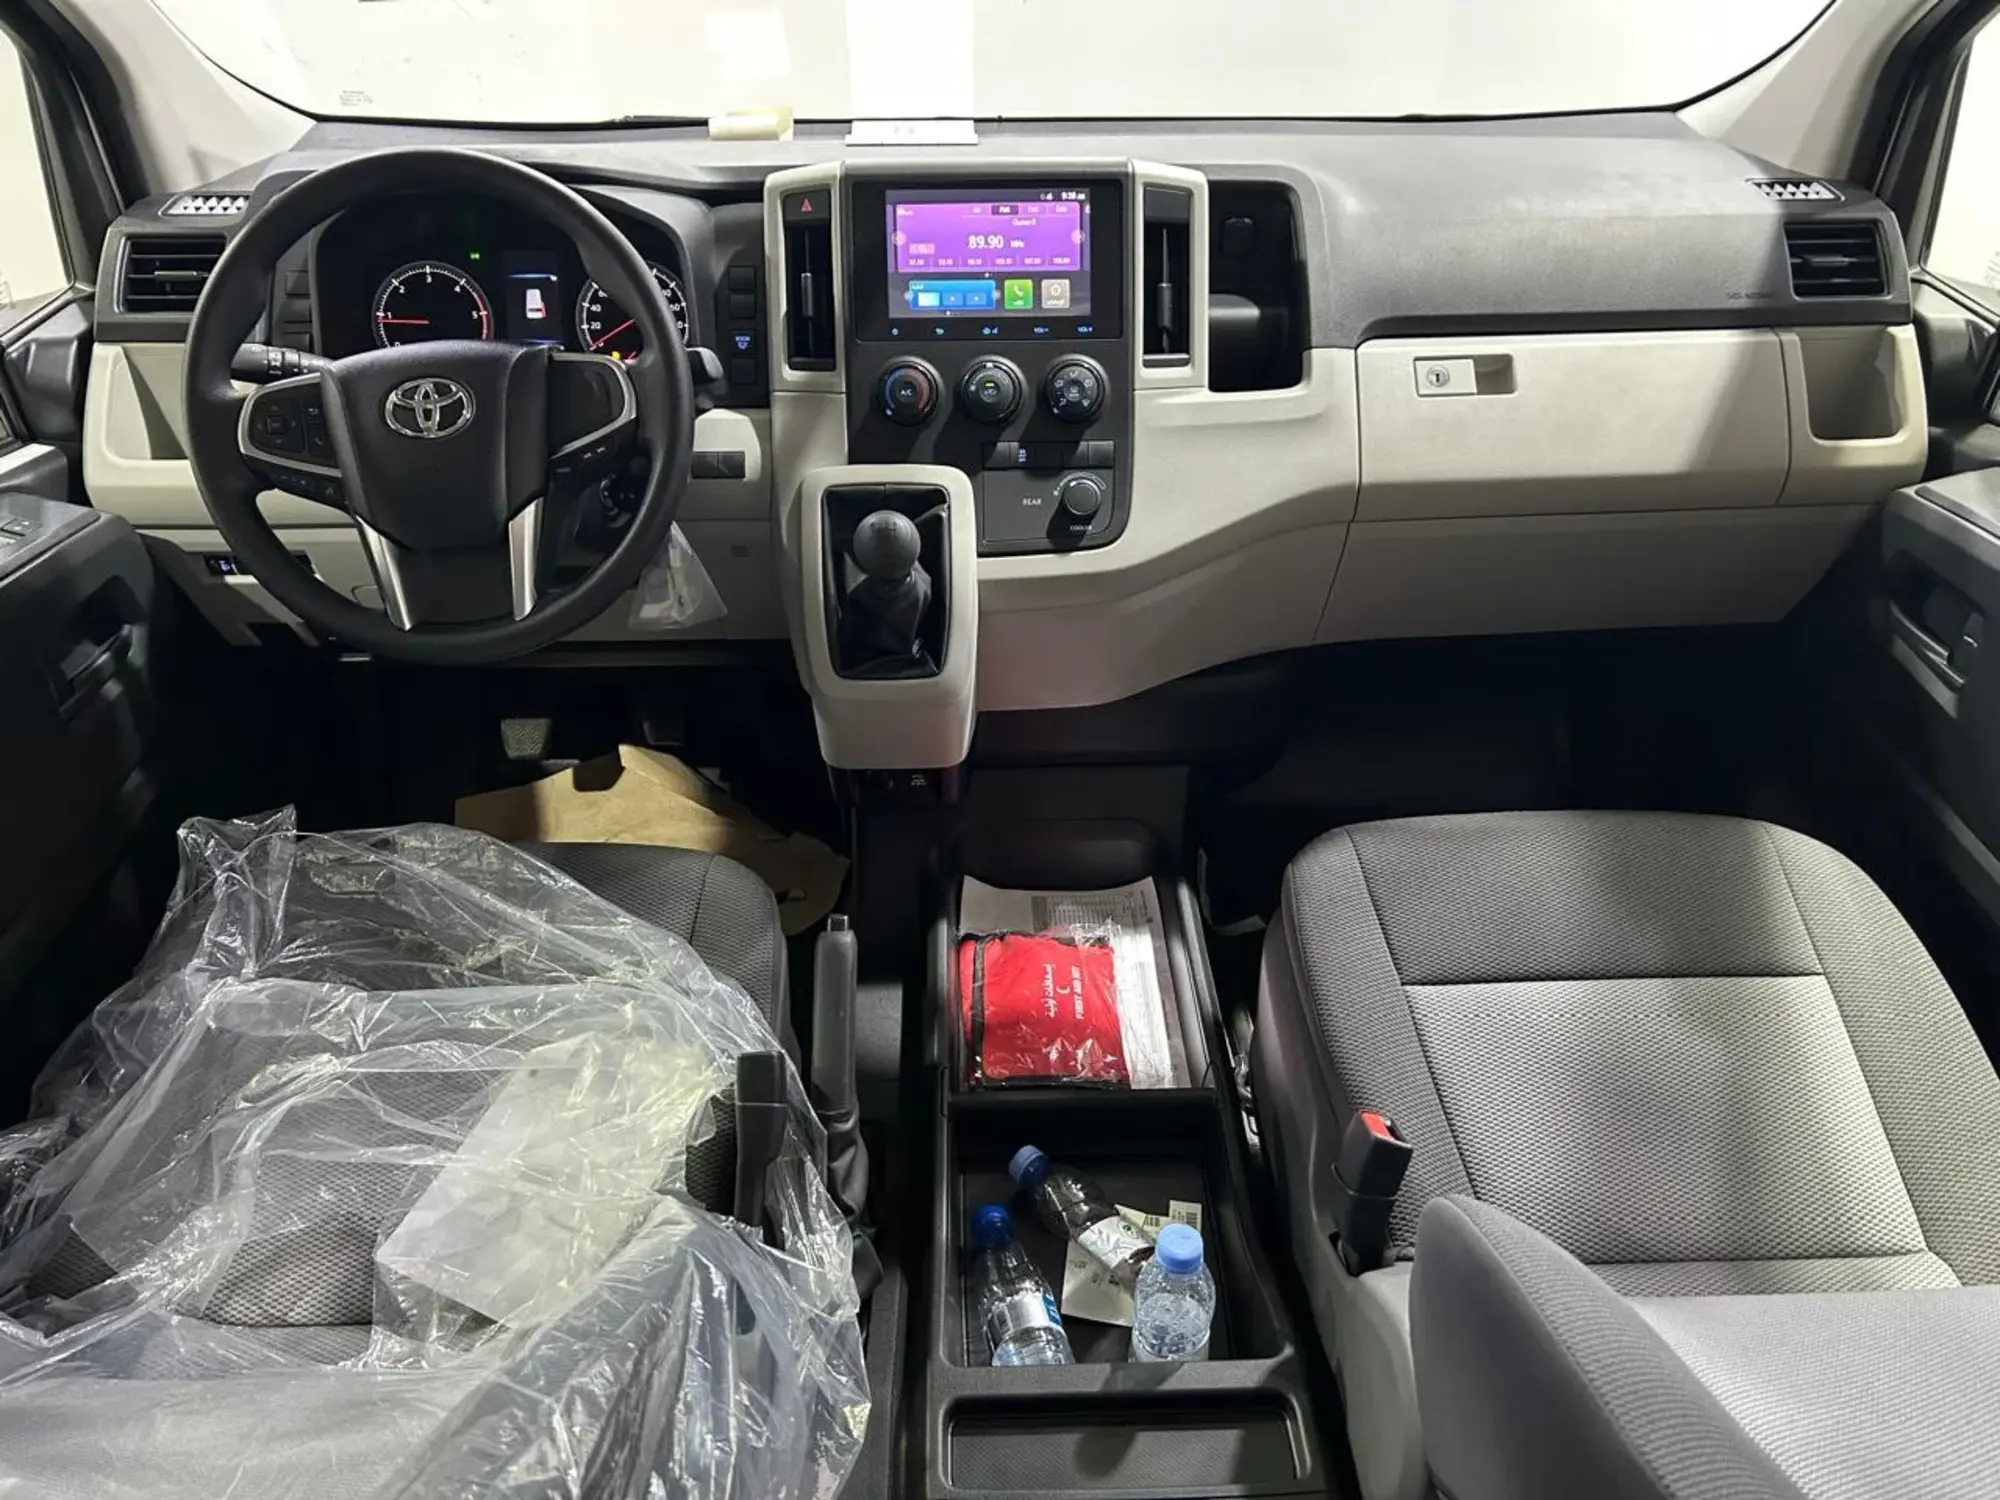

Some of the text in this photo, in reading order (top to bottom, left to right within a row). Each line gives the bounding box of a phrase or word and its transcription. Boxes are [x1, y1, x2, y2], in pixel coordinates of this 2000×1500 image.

[968, 234, 1004, 249] 89.90
[426, 275, 432, 283] 3
[454, 285, 461, 293] 4
[590, 304, 601, 312] 40
[472, 311, 478, 319] 5
[590, 321, 601, 330] 20
[1022, 497, 1042, 506] REAR
[1072, 979, 1082, 994] AID
[1073, 994, 1084, 1020] FIRST
